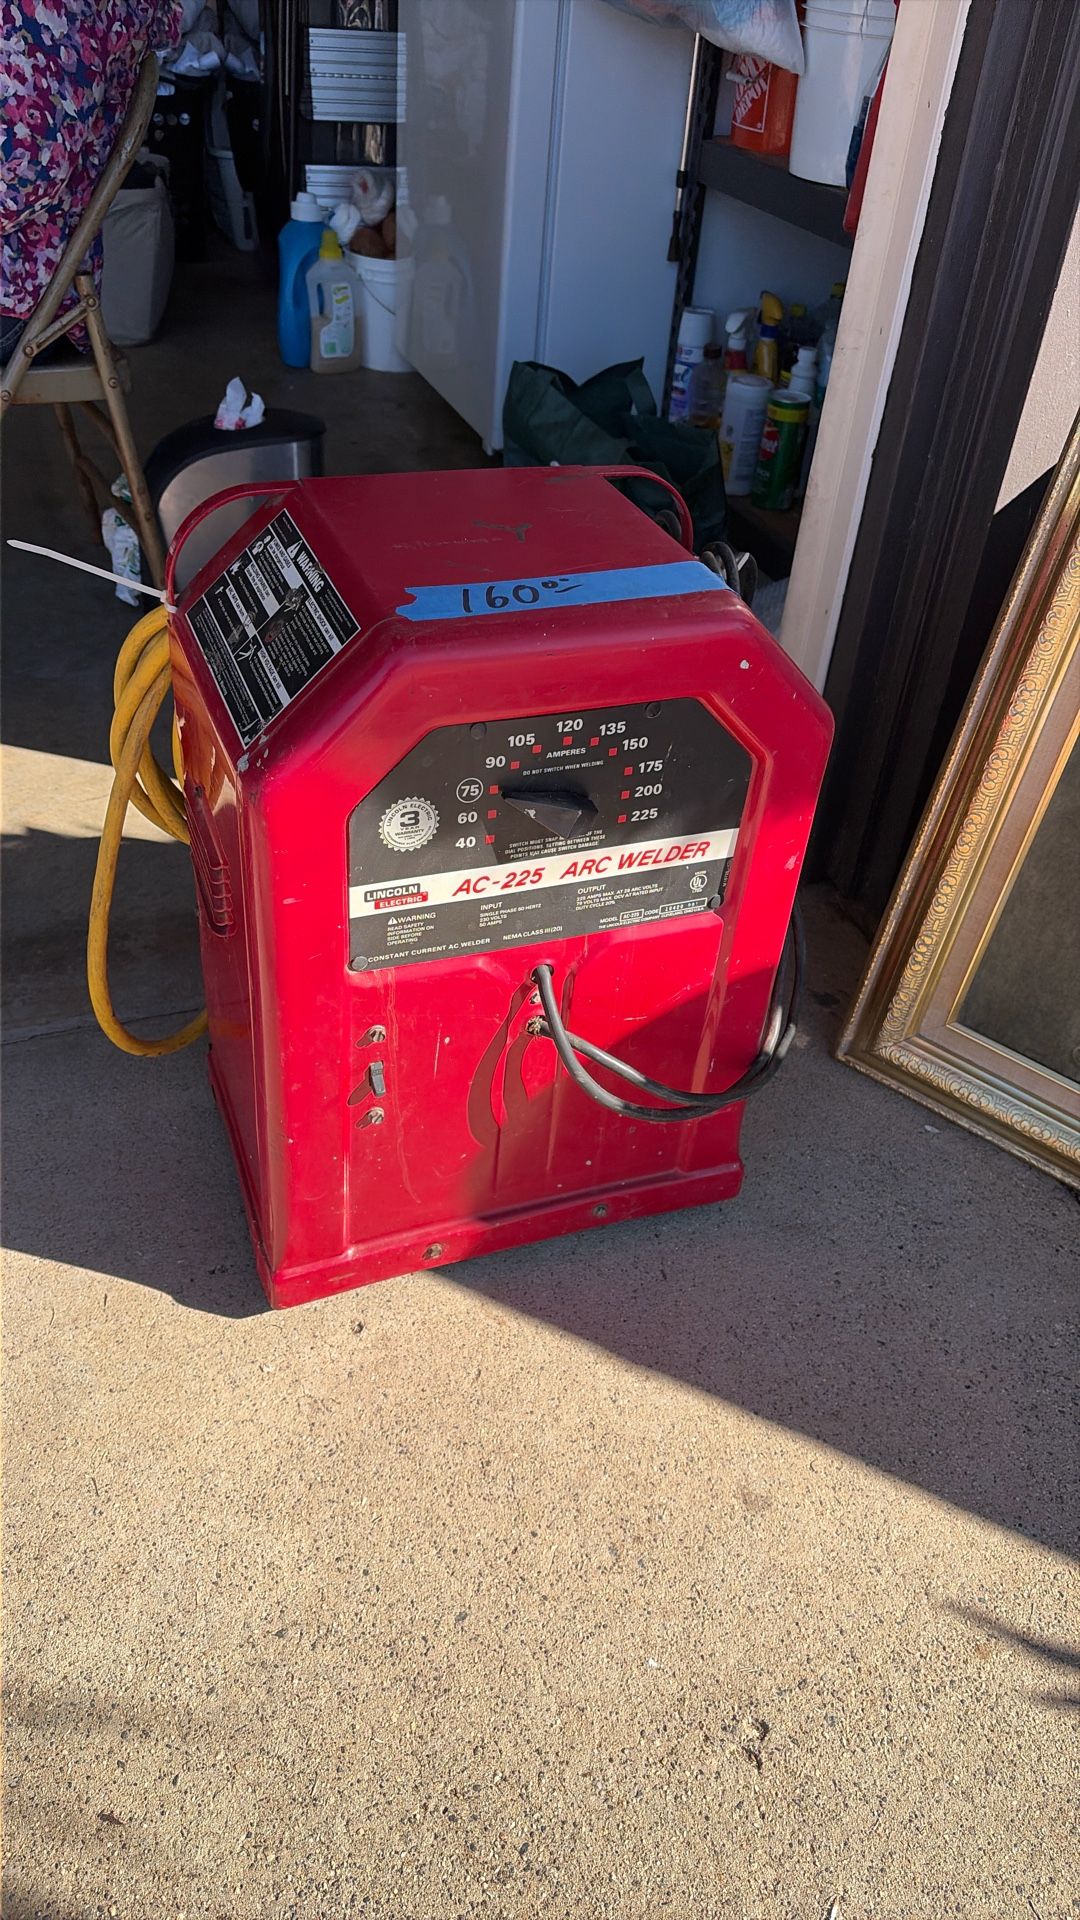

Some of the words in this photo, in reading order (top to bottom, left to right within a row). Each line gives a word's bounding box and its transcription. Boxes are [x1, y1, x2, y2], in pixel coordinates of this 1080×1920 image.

[295, 549, 325, 593] WARNING
[306, 597, 319, 616] ELECTRIC
[556, 719, 584, 732] 120
[599, 721, 626, 736] 135
[508, 733, 536, 747] 105
[622, 737, 648, 750] 150
[546, 748, 586, 759] AMPERES
[485, 756, 506, 768] 90
[581, 760, 604, 768] WELDING
[638, 760, 663, 773] 175
[461, 784, 479, 797] 75
[634, 784, 662, 798] 200
[386, 803, 408, 826] LINCOLN
[410, 803, 432, 820] ELECTRIC
[400, 811, 420, 827] 3
[458, 812, 478, 824] 60
[630, 808, 658, 822] 225
[395, 828, 424, 836] WARRANTY
[456, 836, 476, 848] 40
[510, 840, 528, 848] SWITCH
[567, 837, 589, 845] BETWEEN
[452, 867, 546, 896] AC-225
[560, 856, 612, 879] ARC
[617, 841, 710, 870] WELDER
[367, 885, 418, 901] LINCOLN
[578, 884, 606, 894] OUTPUT
[380, 896, 422, 908] ELECTRIC
[480, 902, 502, 910] INPUT
[398, 912, 436, 923] WARNING
[387, 927, 425, 936] INFORMATION
[503, 932, 522, 940] NEMA
[523, 928, 543, 937] CLASS
[387, 938, 418, 946] OPERATING
[368, 951, 409, 963] CONSTANT
[411, 945, 446, 956] CURRENT
[461, 938, 490, 948] WELDER
